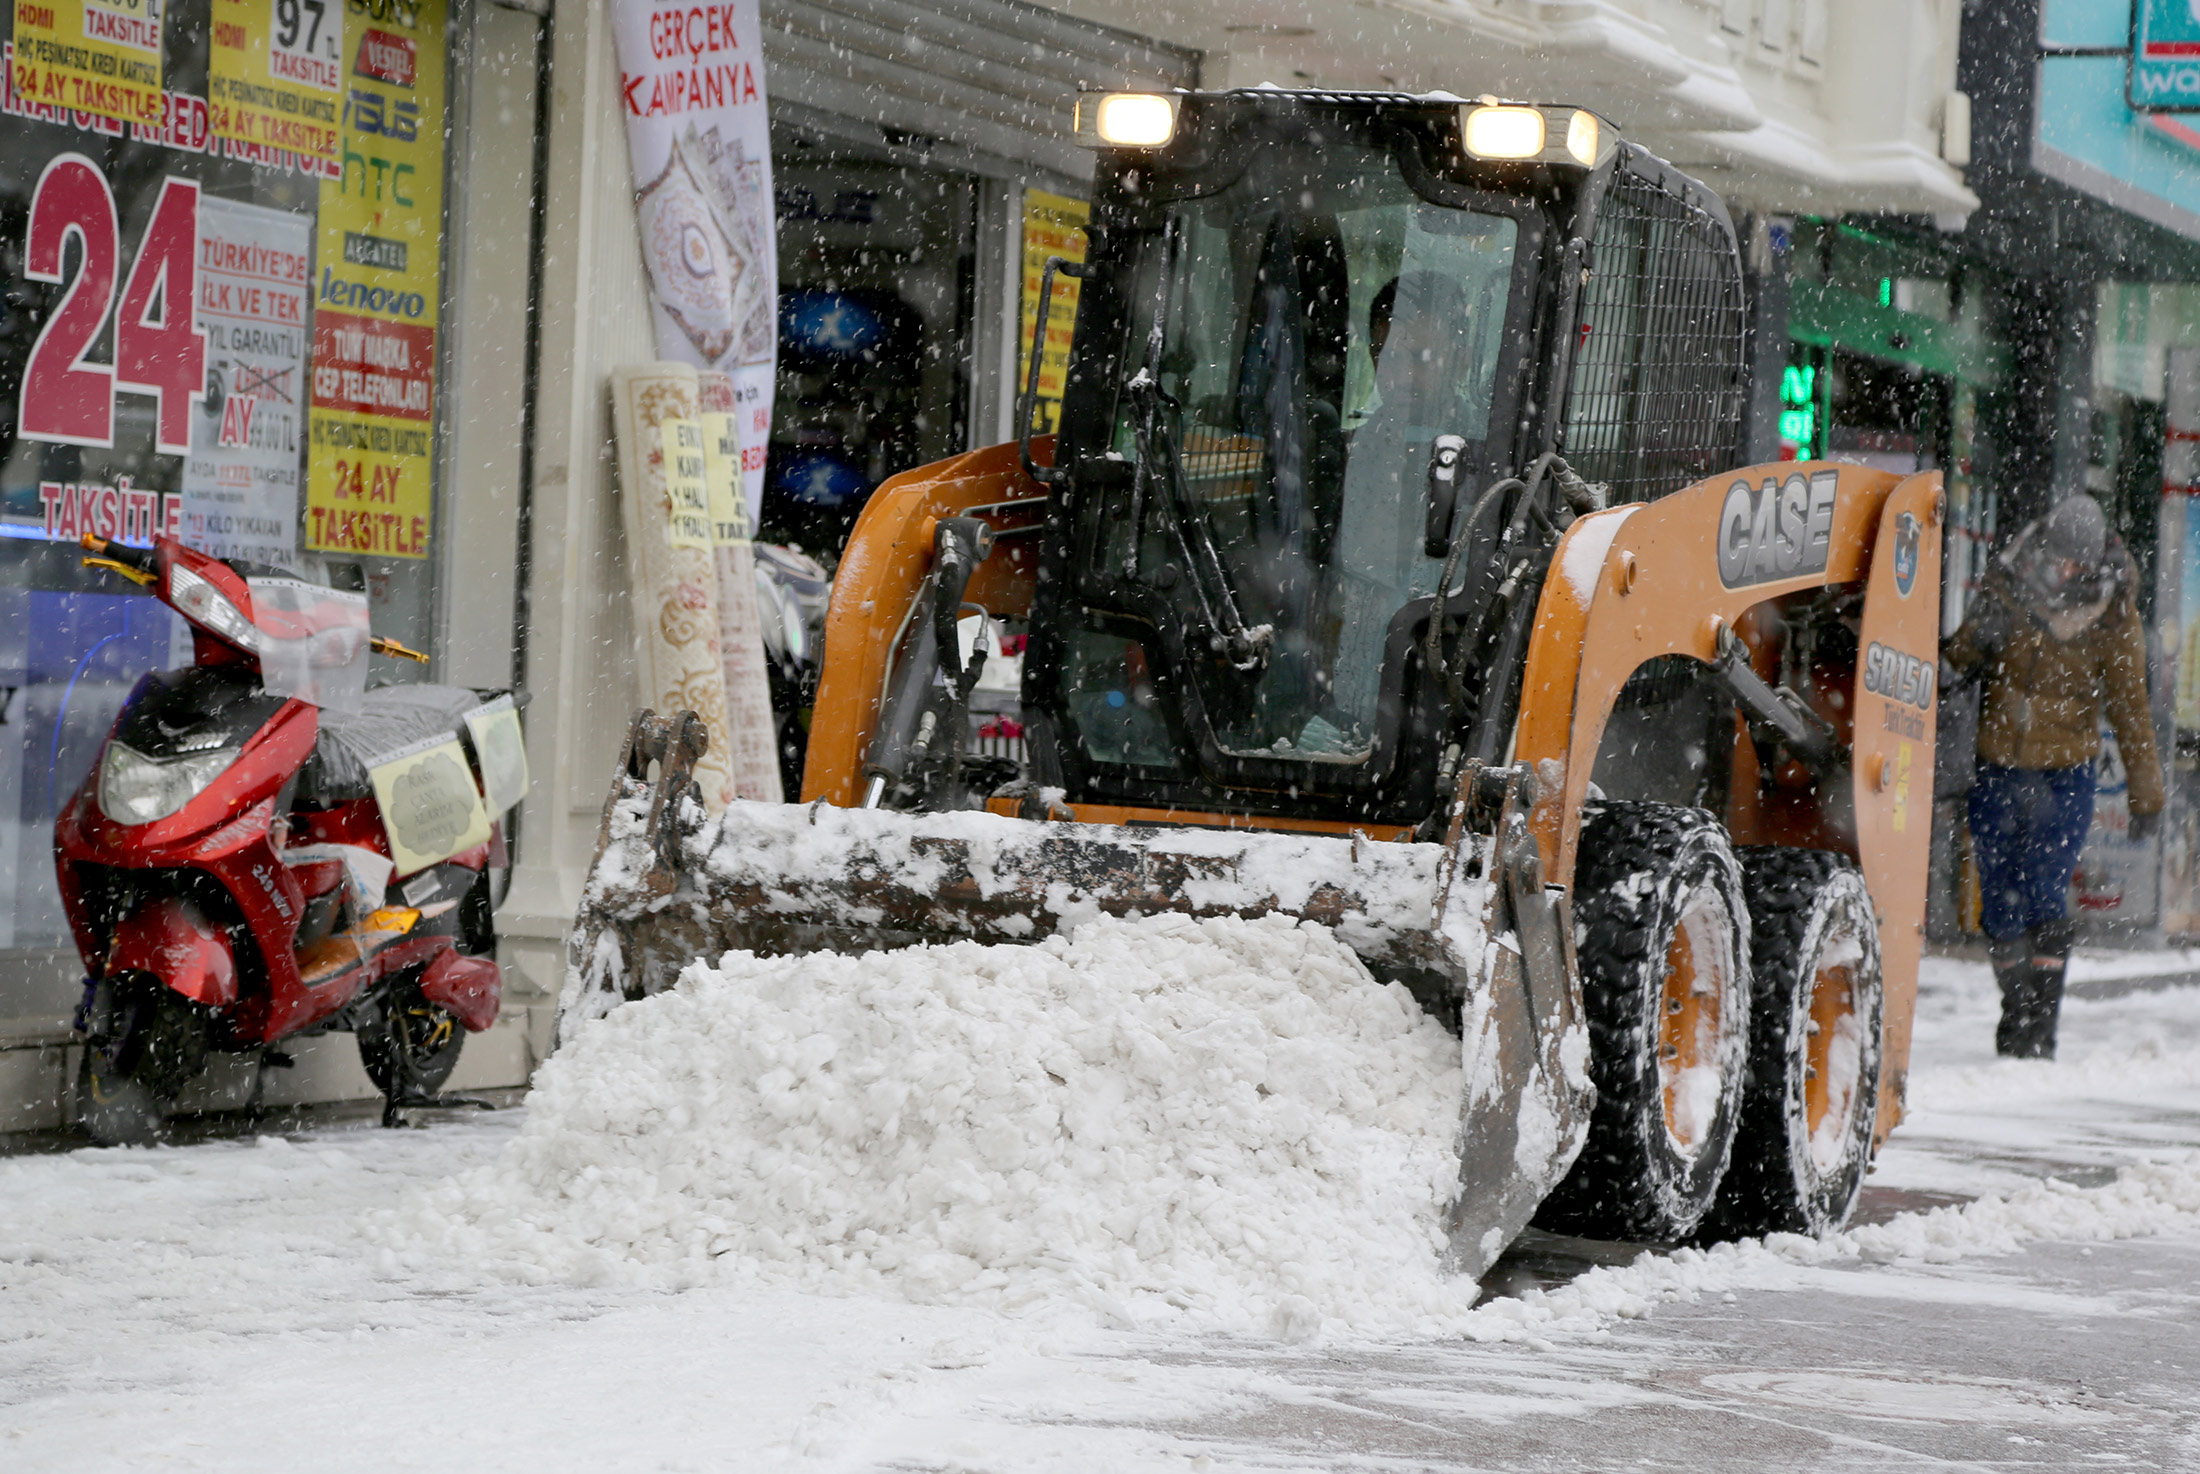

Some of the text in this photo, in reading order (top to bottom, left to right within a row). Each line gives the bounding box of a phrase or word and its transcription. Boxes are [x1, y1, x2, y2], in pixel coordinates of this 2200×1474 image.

[17, 3, 54, 30] HDMI
[214, 20, 247, 52] HDMI
[650, 3, 738, 65] GERÇEK
[366, 41, 412, 75] VESTEL
[16, 65, 38, 96] 24
[43, 71, 67, 101] AY
[622, 61, 759, 118] KAMPANYA
[212, 103, 229, 132] 24
[235, 109, 257, 139] AY
[201, 235, 307, 282] TÜRKİYE'DE
[345, 237, 409, 270] ALCATEL
[17, 152, 207, 456] 24
[237, 285, 262, 315] VE
[267, 290, 301, 322] TEK
[364, 334, 411, 371] MARKA
[314, 365, 430, 411] CEP TELEFONLARI
[218, 392, 257, 448] AY
[334, 459, 401, 505] 24 AY
[1718, 470, 1839, 589] CASE
[1864, 641, 1935, 711] SR150
